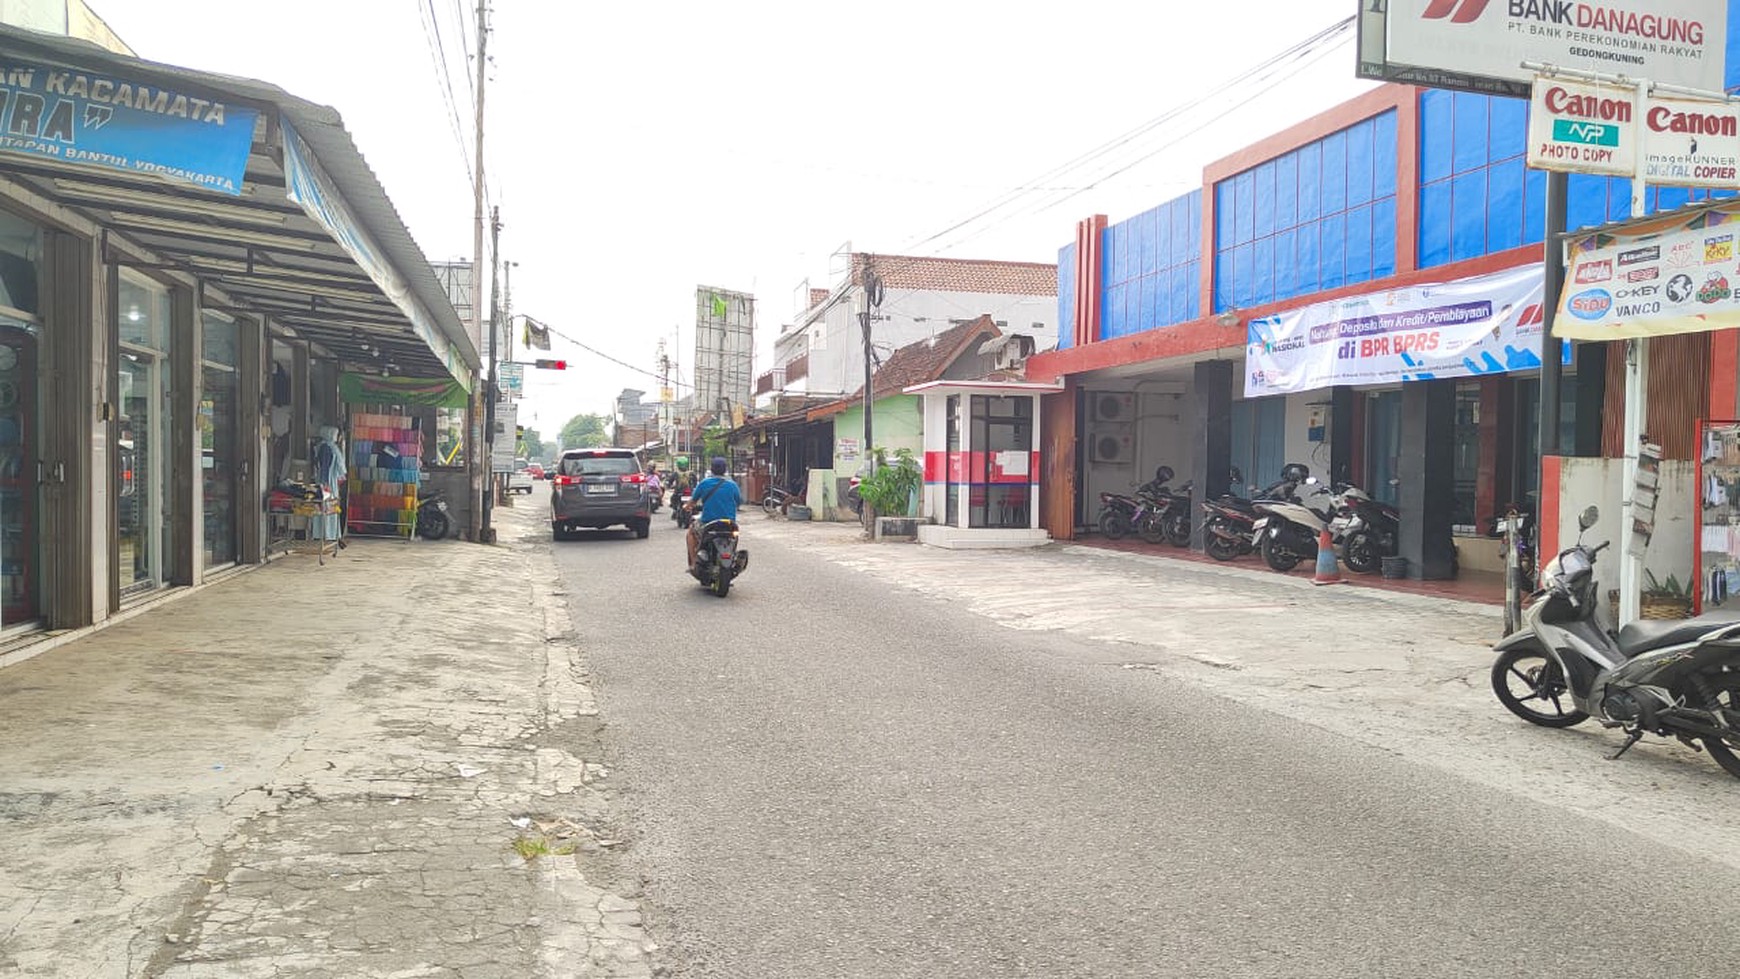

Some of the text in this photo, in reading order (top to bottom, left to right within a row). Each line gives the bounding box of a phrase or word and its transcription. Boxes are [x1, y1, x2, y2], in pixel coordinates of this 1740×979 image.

[1508, 0, 1704, 45] BANK DANAGUNG
[1508, 21, 1702, 60] PT. BANK PEREKONOMIAN RAKYAT
[1568, 46, 1645, 65] GEDONGKUNING
[46, 72, 226, 126] KACAMATA
[1545, 86, 1632, 123] Canon
[1646, 106, 1737, 137] Canon
[1540, 143, 1613, 164] PHOTO COPY
[1645, 154, 1736, 166] imageRUNNER
[65, 147, 128, 167] BANTUL
[135, 158, 234, 191] YOGYAKARTA
[1646, 164, 1736, 180] DIGITAL COPIER
[1616, 301, 1661, 318] VANCO
[1338, 341, 1356, 360] di
[1360, 336, 1390, 358] BPR
[1393, 331, 1440, 354] BPRS
